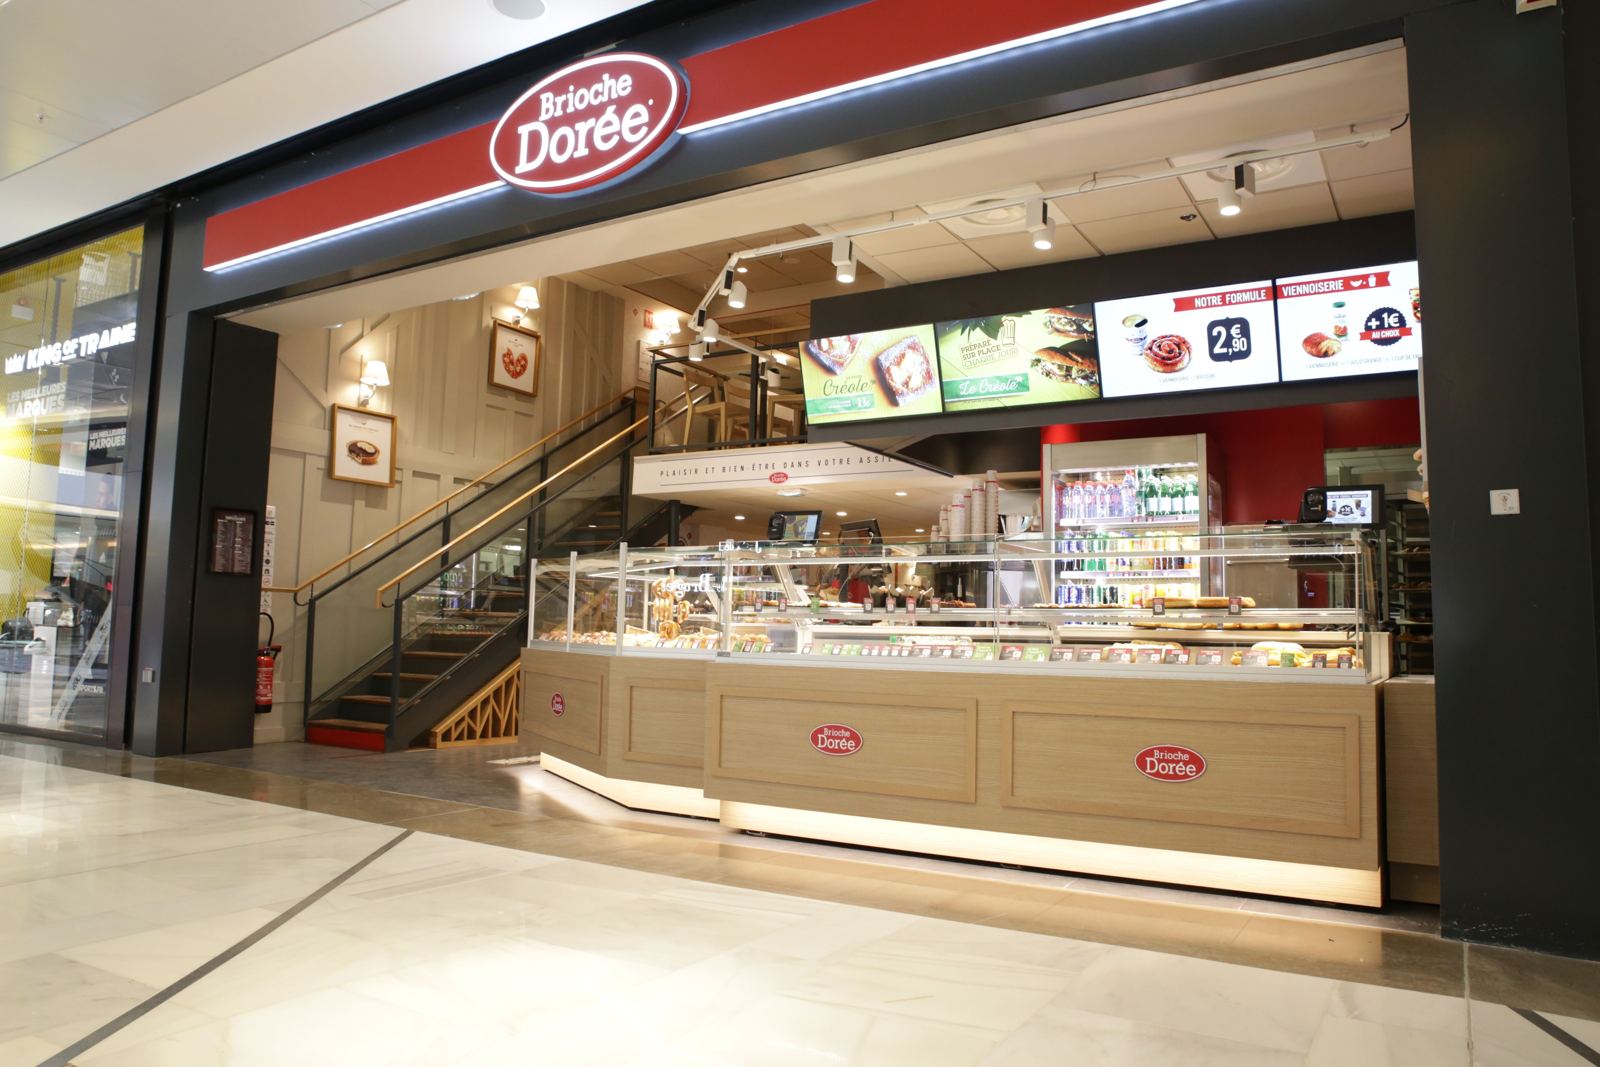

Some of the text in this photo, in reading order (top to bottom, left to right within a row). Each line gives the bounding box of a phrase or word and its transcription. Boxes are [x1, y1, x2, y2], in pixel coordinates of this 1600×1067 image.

[539, 73, 632, 121] Brioche
[515, 104, 648, 174] Dorée
[1282, 280, 1344, 297] VIENNOISERIE
[1194, 289, 1266, 308] NOTRE FORMULE
[1371, 329, 1400, 339] AU CHOIX
[26, 342, 62, 370] KING
[63, 338, 79, 356] OF
[962, 345, 1001, 361] SUR PLACE
[89, 435, 126, 450] MARQUES
[660, 468, 698, 477] PLAISIR
[783, 460, 809, 468] DANS
[817, 457, 850, 467] VOTRE
[823, 727, 851, 737] Brioche
[817, 734, 856, 750] Dorée
[1153, 749, 1189, 761] Brioche
[1145, 757, 1197, 776] Dorée
